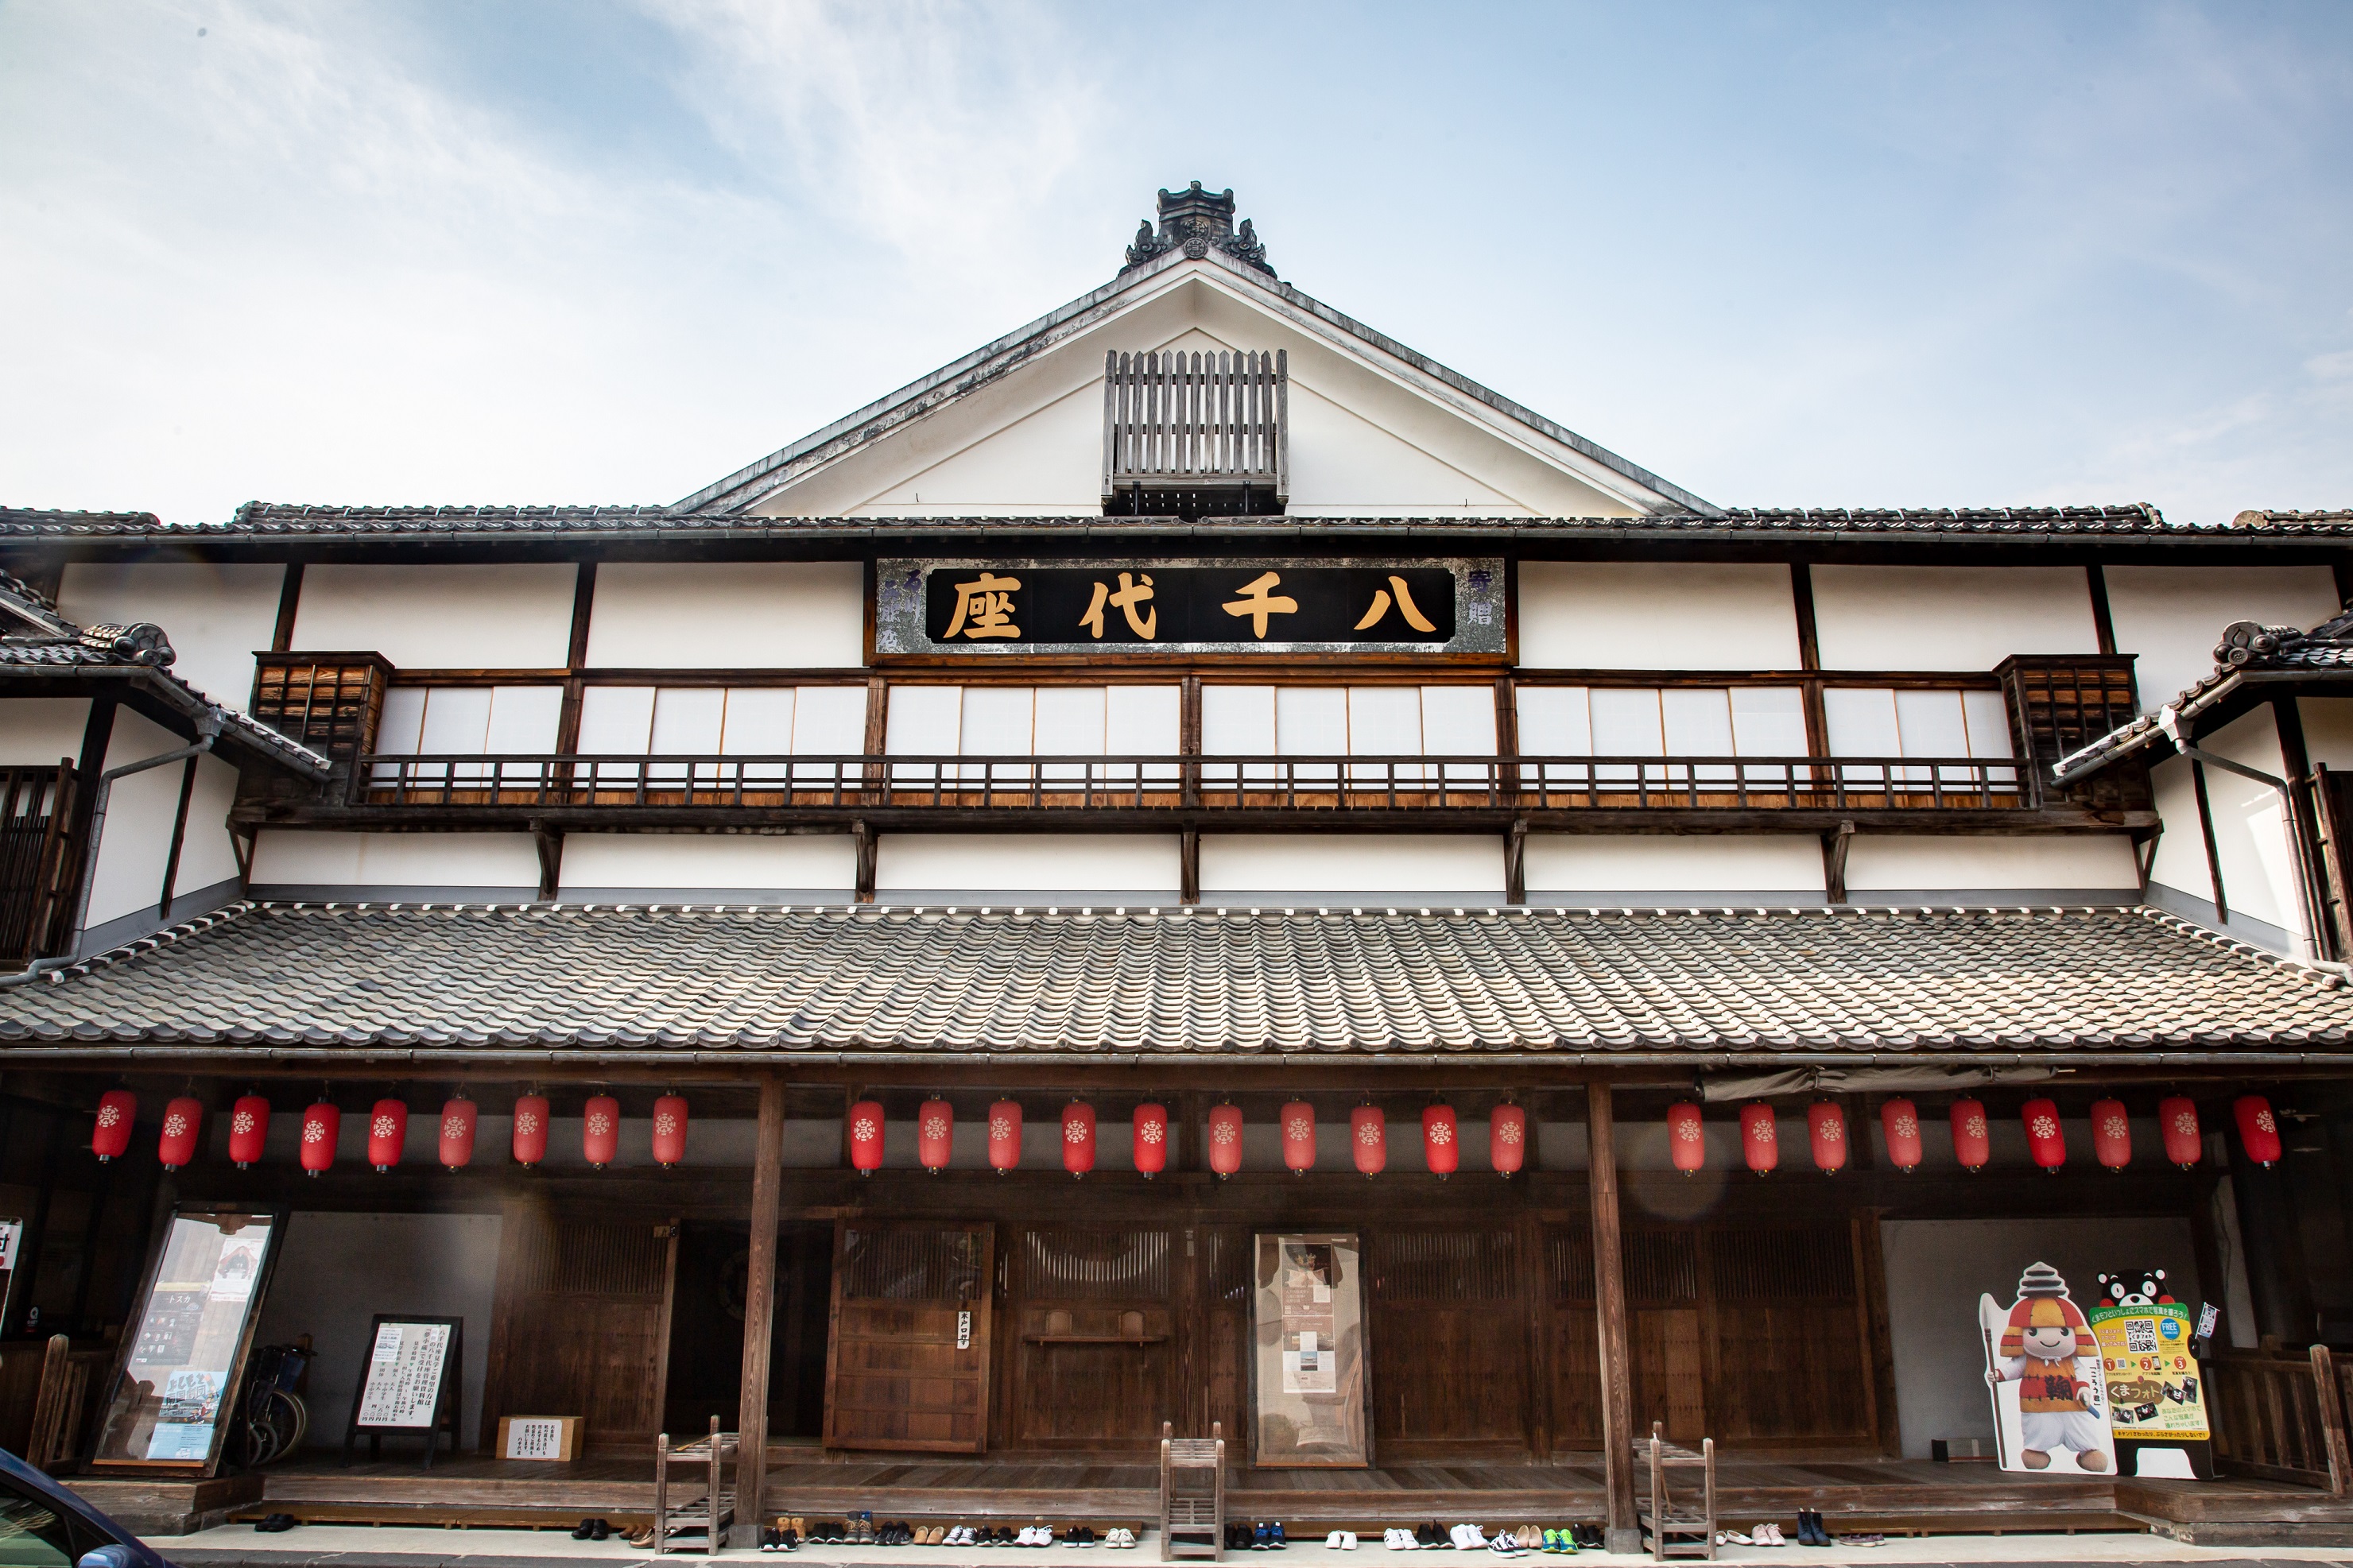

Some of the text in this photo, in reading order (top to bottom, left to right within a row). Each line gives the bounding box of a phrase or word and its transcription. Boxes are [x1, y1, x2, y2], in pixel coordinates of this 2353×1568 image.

[1467, 569, 1493, 625] 寄贈
[943, 571, 1436, 639] 八千代座
[169, 1295, 191, 1303] トスカ
[2162, 1322, 2177, 1331] FREE
[2111, 1384, 2160, 1399] くまフォト
